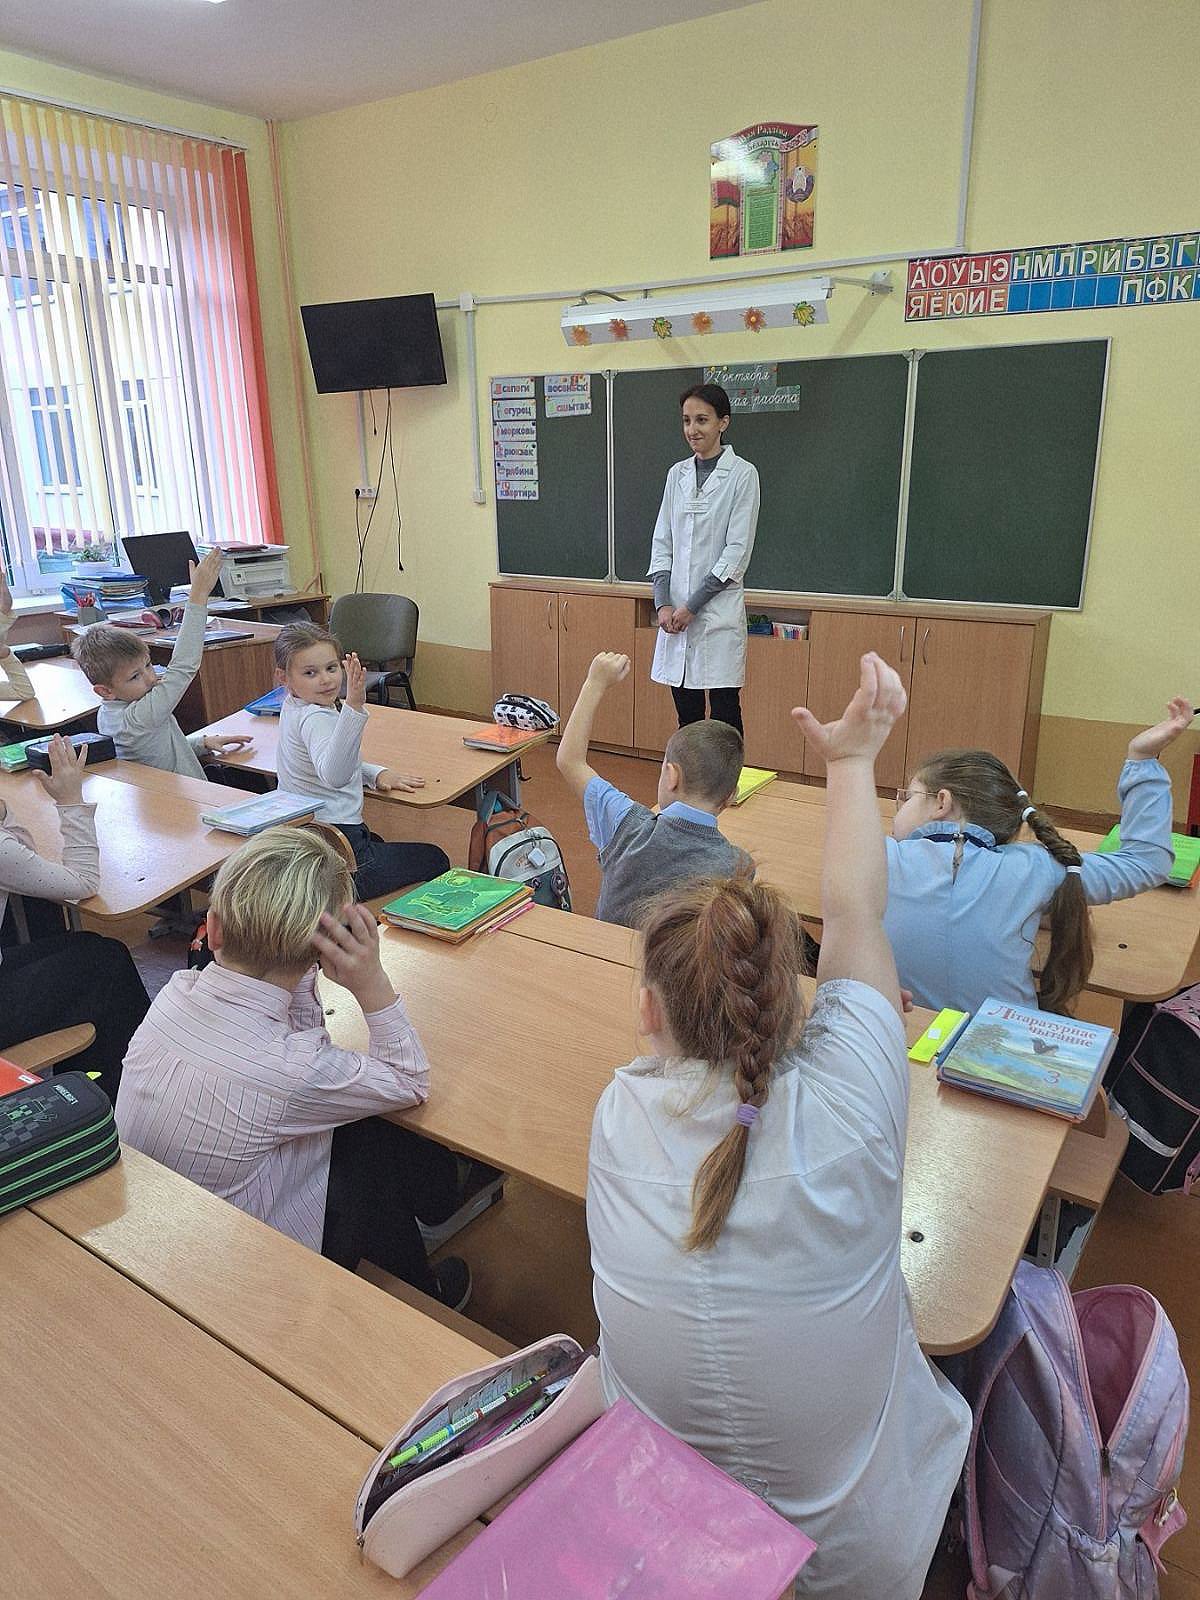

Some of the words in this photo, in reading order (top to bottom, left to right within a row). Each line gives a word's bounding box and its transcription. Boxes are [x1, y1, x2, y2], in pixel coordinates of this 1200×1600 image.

[502, 384, 530, 392] сапоги
[504, 406, 531, 417] огурец
[1029, 1025, 1094, 1048] чытанне
[1044, 1071, 1060, 1084] 3
